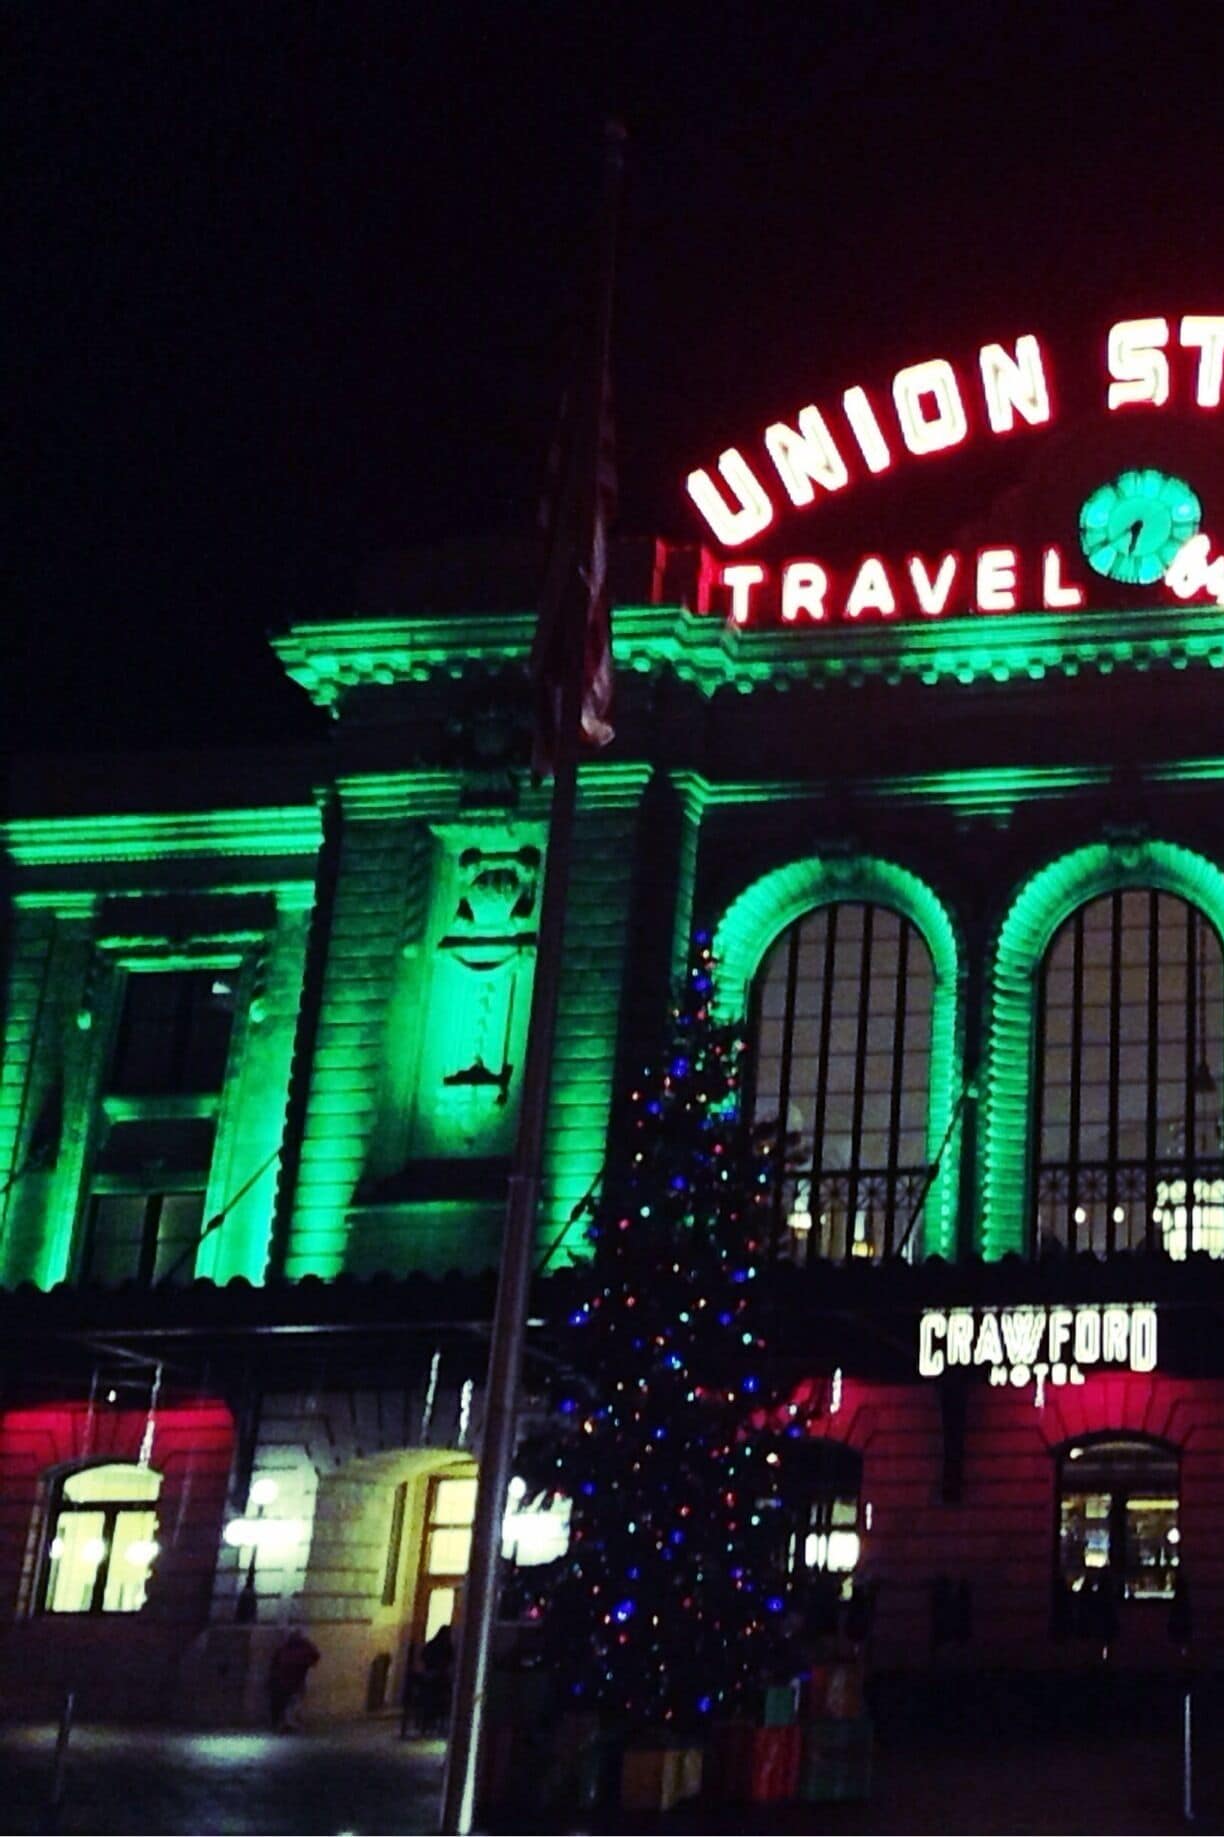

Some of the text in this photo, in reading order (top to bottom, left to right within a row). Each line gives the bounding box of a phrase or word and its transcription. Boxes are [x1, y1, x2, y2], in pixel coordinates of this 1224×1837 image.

[687, 335, 1050, 546] UNION
[723, 549, 1082, 623] TRAVEL
[918, 1307, 1158, 1377] CRAWFORD
[989, 1363, 1086, 1388] HOTEL
